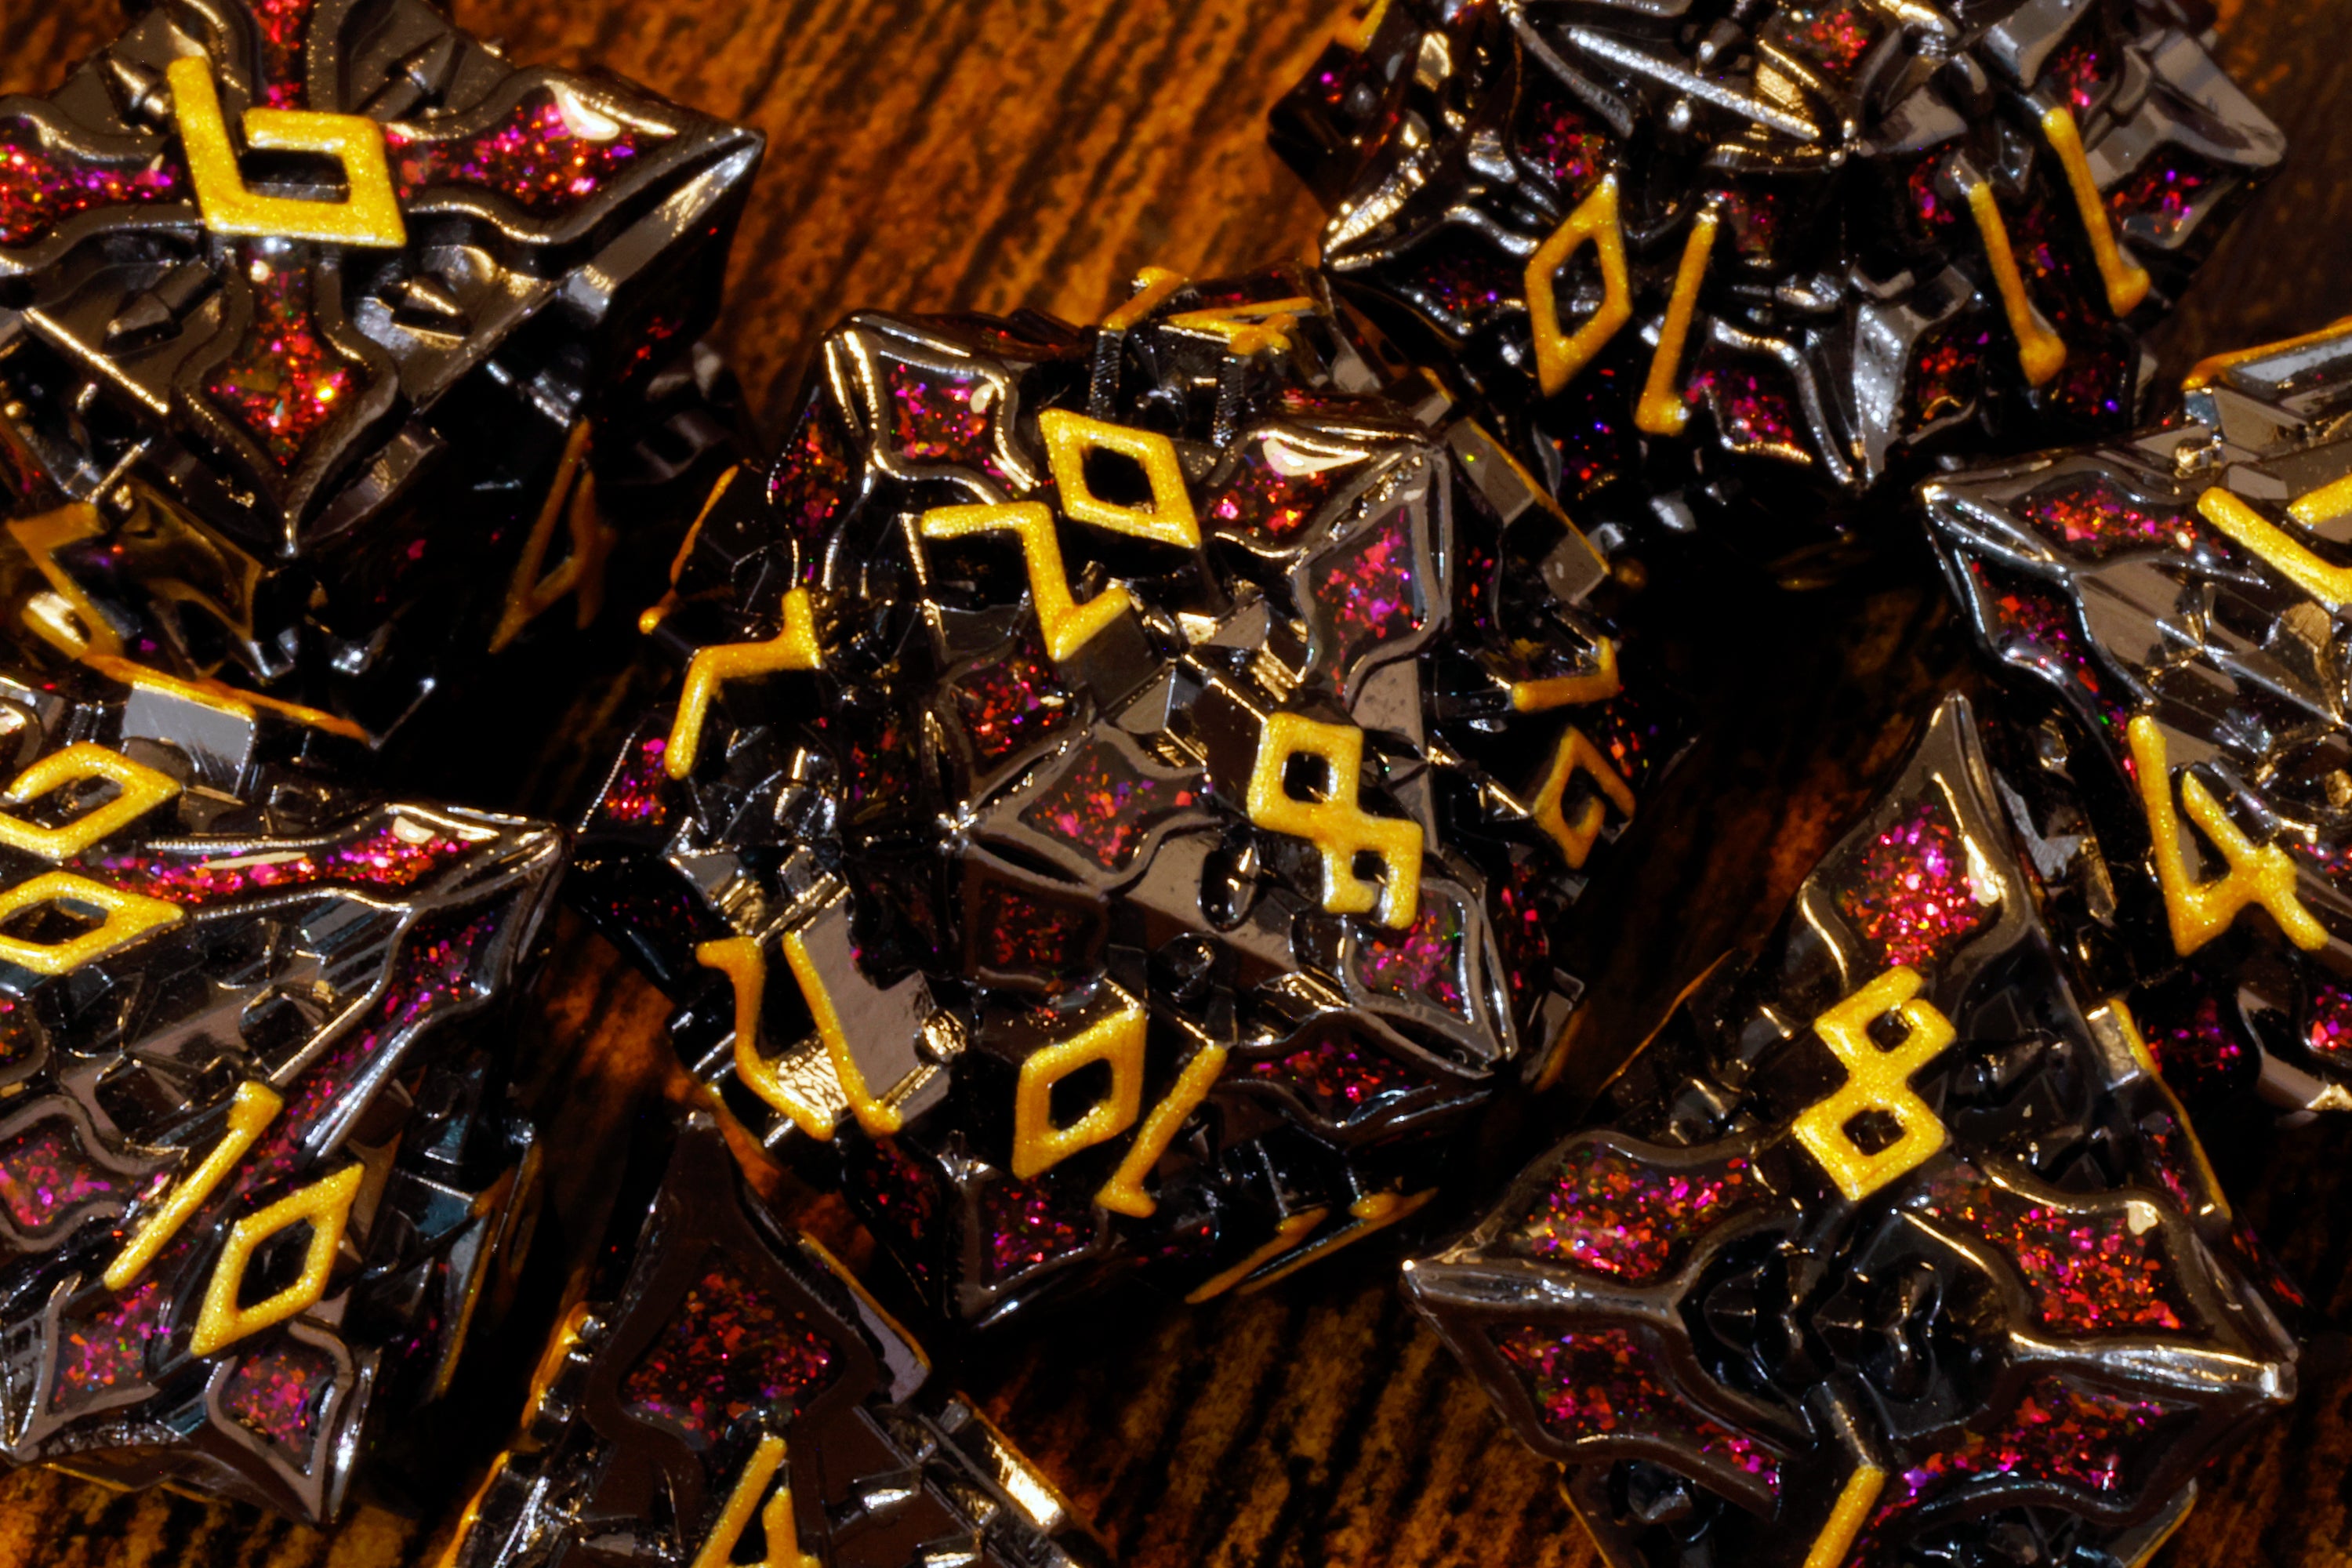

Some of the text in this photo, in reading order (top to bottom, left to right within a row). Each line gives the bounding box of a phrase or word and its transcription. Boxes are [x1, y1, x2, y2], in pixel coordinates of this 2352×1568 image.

[1247, 712, 1423, 930] 8
[2128, 715, 2328, 957] 4
[1791, 965, 1956, 1200] 8
